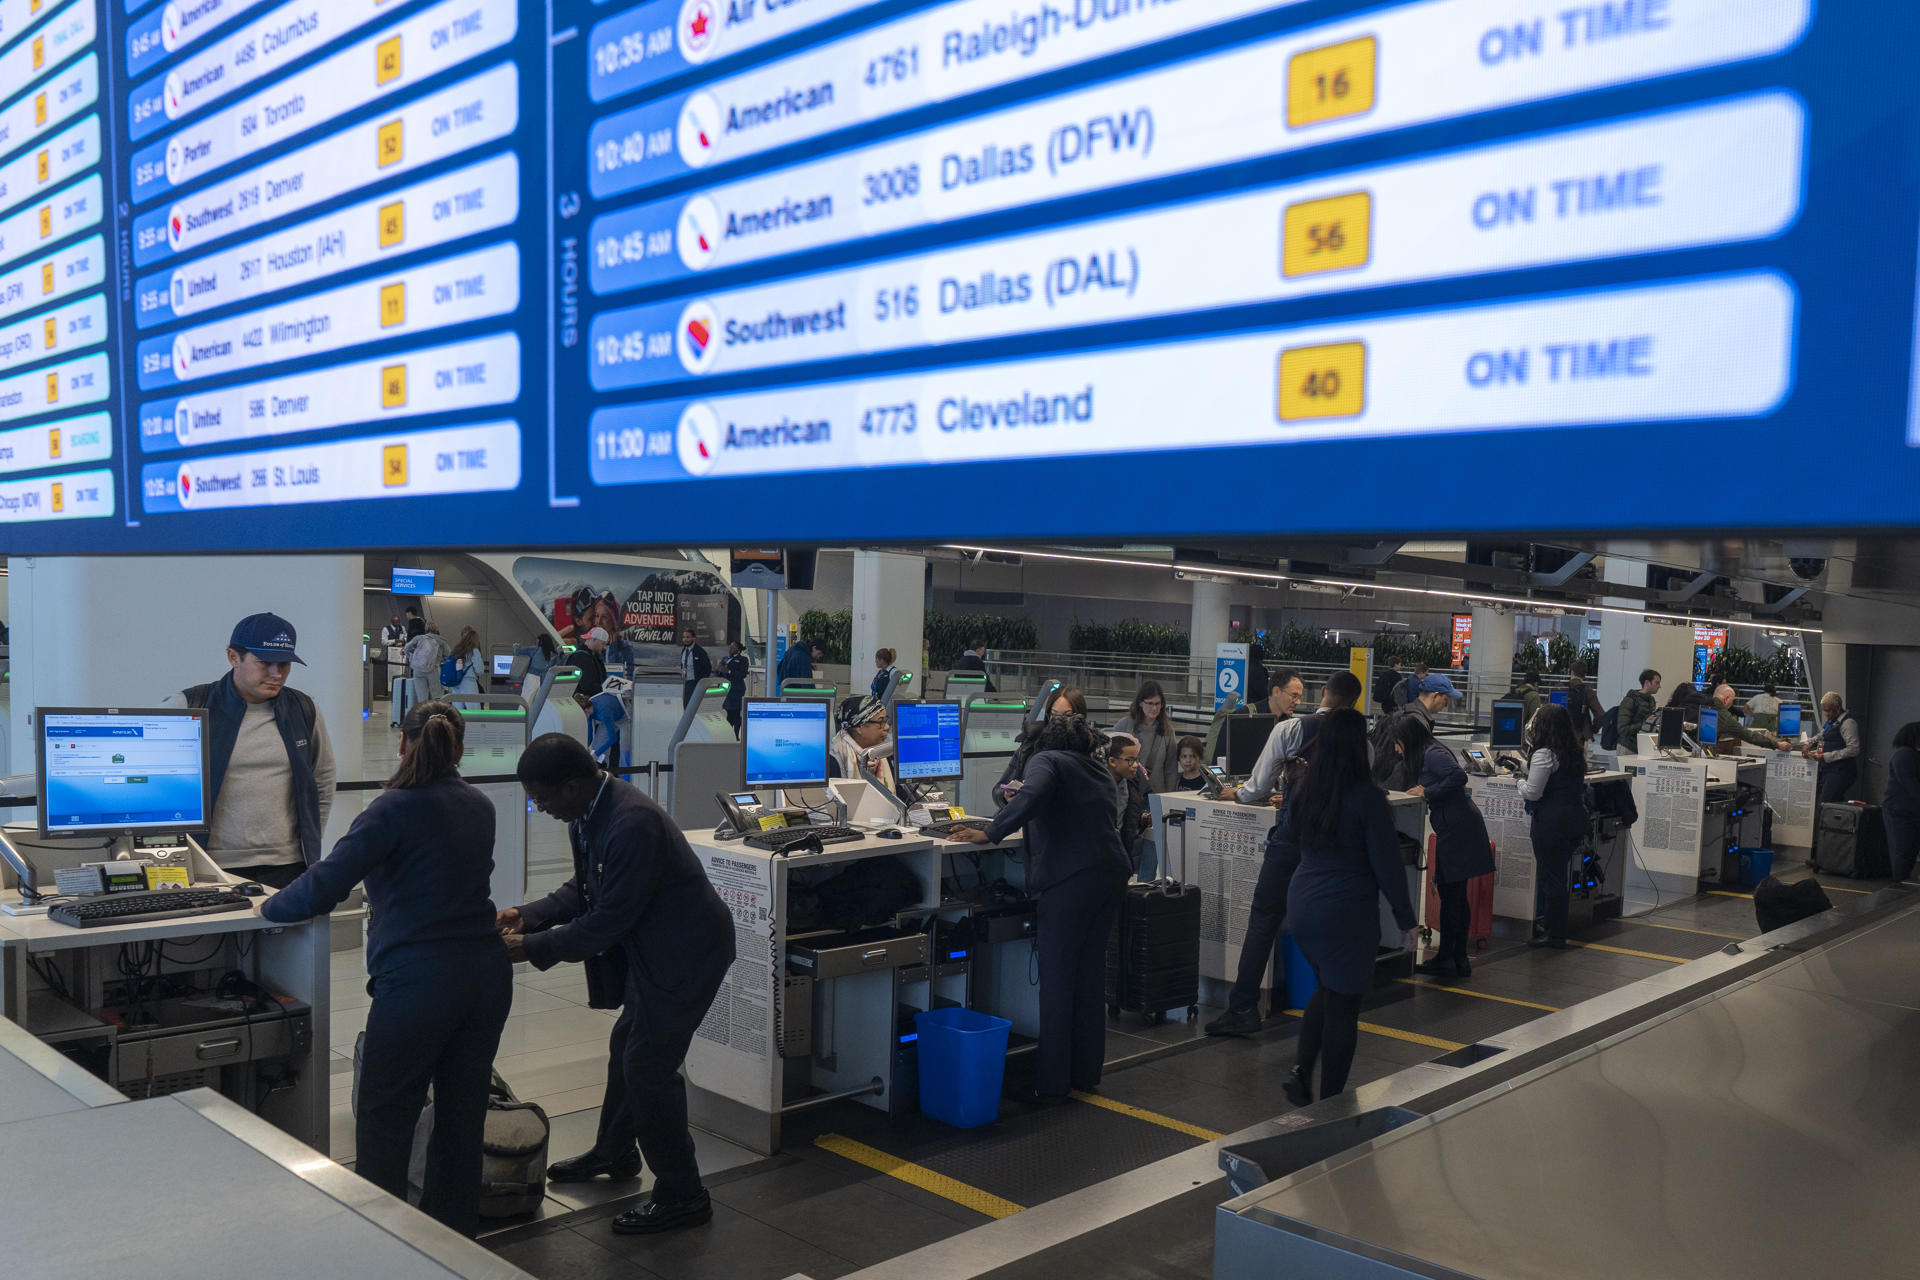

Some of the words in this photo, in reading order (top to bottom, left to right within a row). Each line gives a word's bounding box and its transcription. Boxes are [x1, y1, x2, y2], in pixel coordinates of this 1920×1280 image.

[183, 64, 224, 97] American
[263, 11, 318, 54] Columbus
[184, 140, 212, 164] Porter
[264, 95, 305, 127] Toronto
[430, 27, 449, 50] ON
[452, 9, 482, 39] TIME
[594, 130, 645, 174] 10:40
[646, 128, 672, 160] AM
[726, 84, 834, 134] American
[864, 46, 920, 89] 4761
[1314, 66, 1352, 104] 16
[1478, 16, 1543, 67] ON
[1556, 0, 1672, 50] TIME
[595, 31, 644, 76] 10:35
[646, 26, 672, 58] AM
[186, 198, 234, 232] Southwest
[266, 172, 304, 202] Denver
[432, 114, 450, 136] ON
[452, 99, 483, 128] TIME
[596, 230, 644, 270] 10:45
[646, 229, 672, 258] AM
[725, 193, 833, 239] American
[862, 162, 920, 206] 3008
[940, 142, 1034, 191] Dallas
[1048, 105, 1155, 178] (DFW)
[1306, 220, 1346, 256] 56
[1470, 184, 1536, 232] ON
[1550, 162, 1664, 218] TIME
[558, 189, 581, 219] 3
[188, 272, 217, 297] United
[268, 244, 312, 274] Houston
[316, 230, 346, 264] (IAH)
[434, 198, 452, 221] ON
[454, 187, 484, 214] TIME
[191, 341, 232, 362] American
[269, 314, 330, 344] Wilmington
[434, 285, 452, 305] ON
[455, 274, 485, 300] TIME
[560, 235, 578, 348] HOURS
[596, 331, 644, 366] 10:45
[646, 332, 672, 358] AM
[724, 300, 846, 347] Southwest
[875, 286, 920, 321] 516
[939, 272, 1032, 314] Dallas
[1044, 246, 1140, 310] (DAL)
[1300, 368, 1342, 401] 40
[1464, 346, 1531, 390] ON
[1542, 332, 1655, 383] TIME
[192, 408, 222, 429] United
[272, 396, 310, 417] Denver
[435, 369, 454, 390] ON
[456, 362, 486, 385] TIME
[596, 428, 645, 460] 11:00
[646, 431, 672, 456] AM
[724, 418, 831, 450] American
[862, 400, 917, 437] 4773
[936, 382, 1094, 434] Cleveland
[196, 472, 242, 494] Southwest
[274, 466, 286, 488] St.
[289, 462, 320, 486] Louis
[436, 452, 454, 472] ON
[458, 448, 486, 470] TIME
[624, 614, 674, 626] ADVENTURE
[626, 602, 651, 614] YOUR
[653, 603, 674, 614] NEXT
[637, 590, 652, 602] TAP
[654, 592, 674, 602] INTO
[634, 628, 661, 641] TRAVEL
[662, 632, 674, 641] ON
[1224, 672, 1232, 688] 2
[712, 856, 724, 864] ADVICE
[732, 860, 757, 871] PASSENGERS
